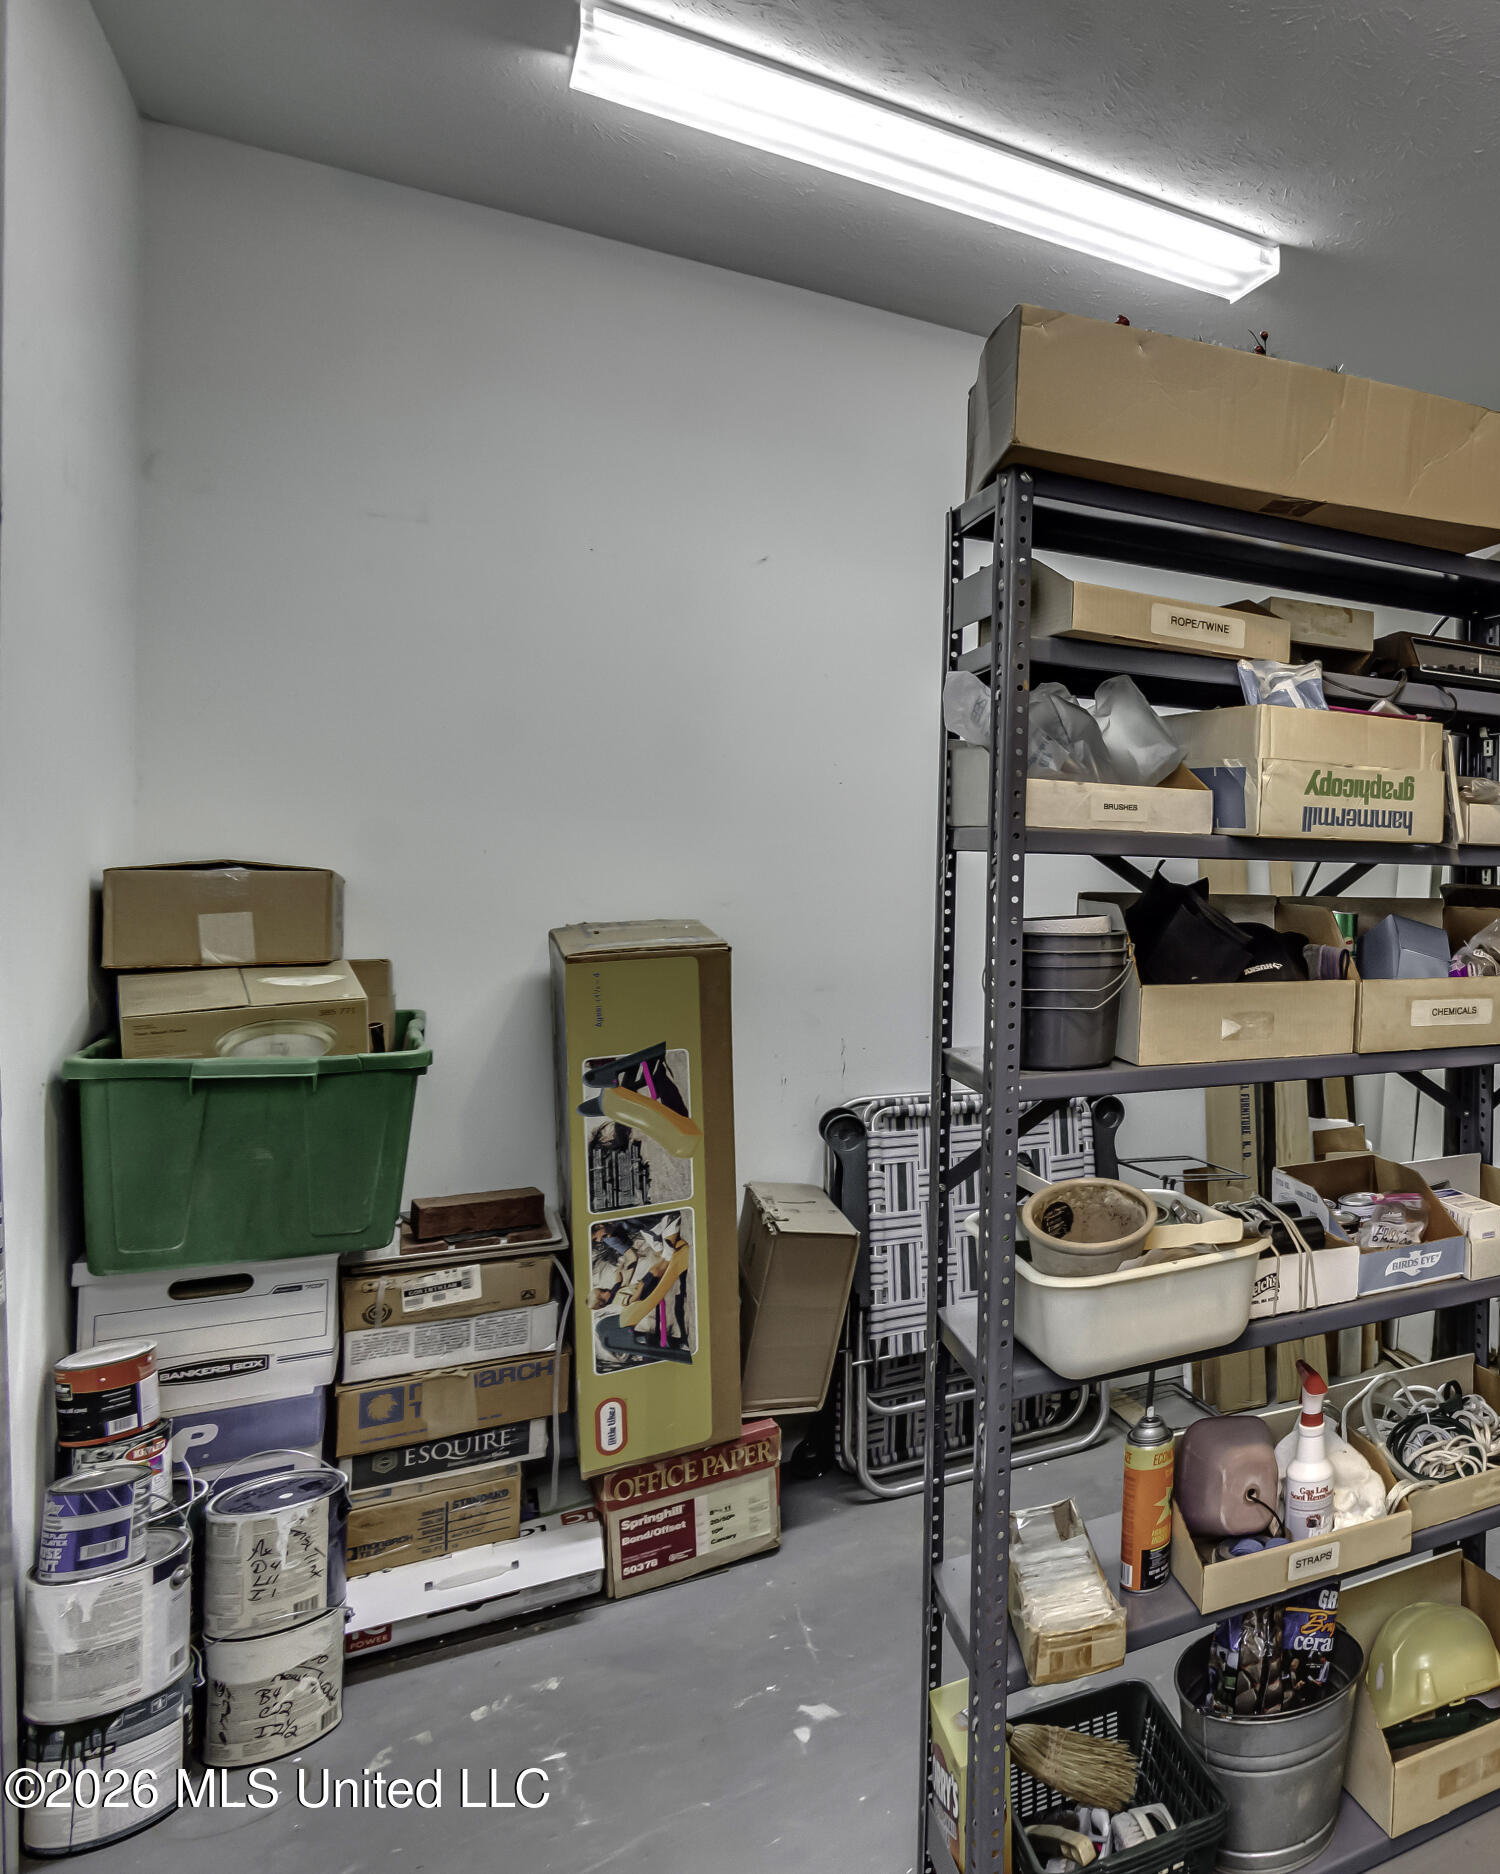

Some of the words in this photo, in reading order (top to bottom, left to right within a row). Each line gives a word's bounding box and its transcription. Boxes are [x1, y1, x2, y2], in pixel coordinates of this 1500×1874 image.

[1170, 616, 1230, 634] ROPE/TWINE
[1304, 769, 1415, 805] graphicopy
[1103, 803, 1138, 811] BRUSHES
[1301, 806, 1413, 836] hammermill
[1431, 1006, 1477, 1017] CHEMICALS
[1240, 1094, 1251, 1135] FURNITURE
[1392, 1258, 1418, 1271] BIRDS
[1420, 1255, 1437, 1265] EYE
[159, 1362, 230, 1382] BANKERS
[232, 1359, 263, 1370] BOX
[404, 1428, 512, 1467] ESQUIRE
[614, 1461, 698, 1501] OFFICE
[702, 1440, 773, 1479] PAPER
[453, 1489, 510, 1509] STANDARD
[621, 1504, 684, 1532] Springhill
[621, 1521, 686, 1546] Bond/Offset
[1295, 1550, 1333, 1568] STRAPS
